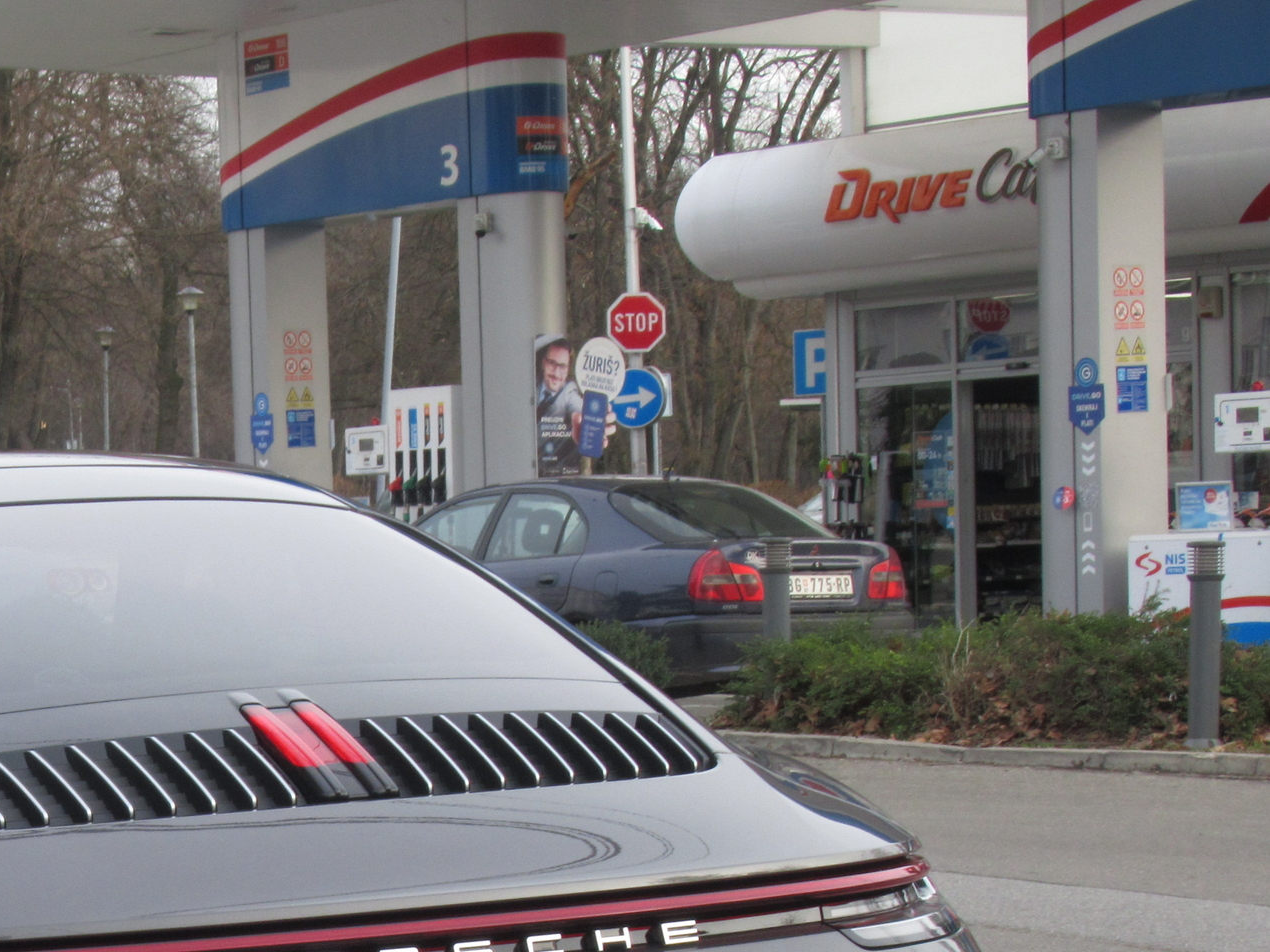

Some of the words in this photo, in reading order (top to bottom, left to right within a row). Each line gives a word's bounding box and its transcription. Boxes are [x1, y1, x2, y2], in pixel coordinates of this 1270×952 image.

[440, 144, 459, 186] 3
[824, 168, 973, 223] DRIVE
[614, 312, 659, 332] STOP
[582, 350, 620, 376] ŽURIŠ?
[805, 338, 826, 388] P
[1165, 553, 1186, 565] NIS
